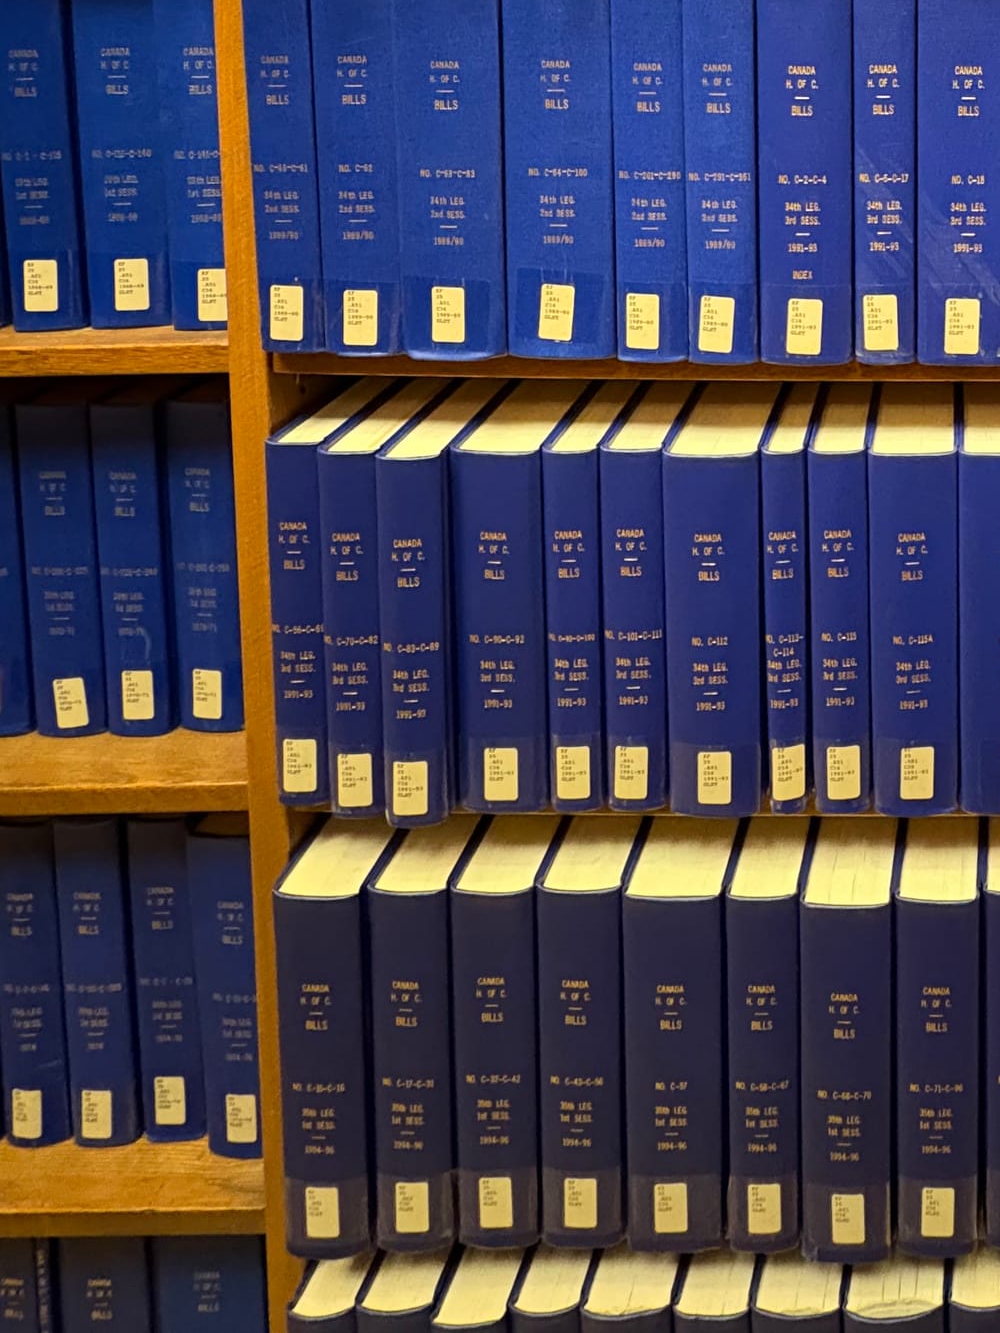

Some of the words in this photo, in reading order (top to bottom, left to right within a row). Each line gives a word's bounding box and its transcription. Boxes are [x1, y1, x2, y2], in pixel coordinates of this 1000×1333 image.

[788, 66, 815, 75] CANADA
[797, 79, 806, 89] OF
[792, 105, 813, 116] BILLS
